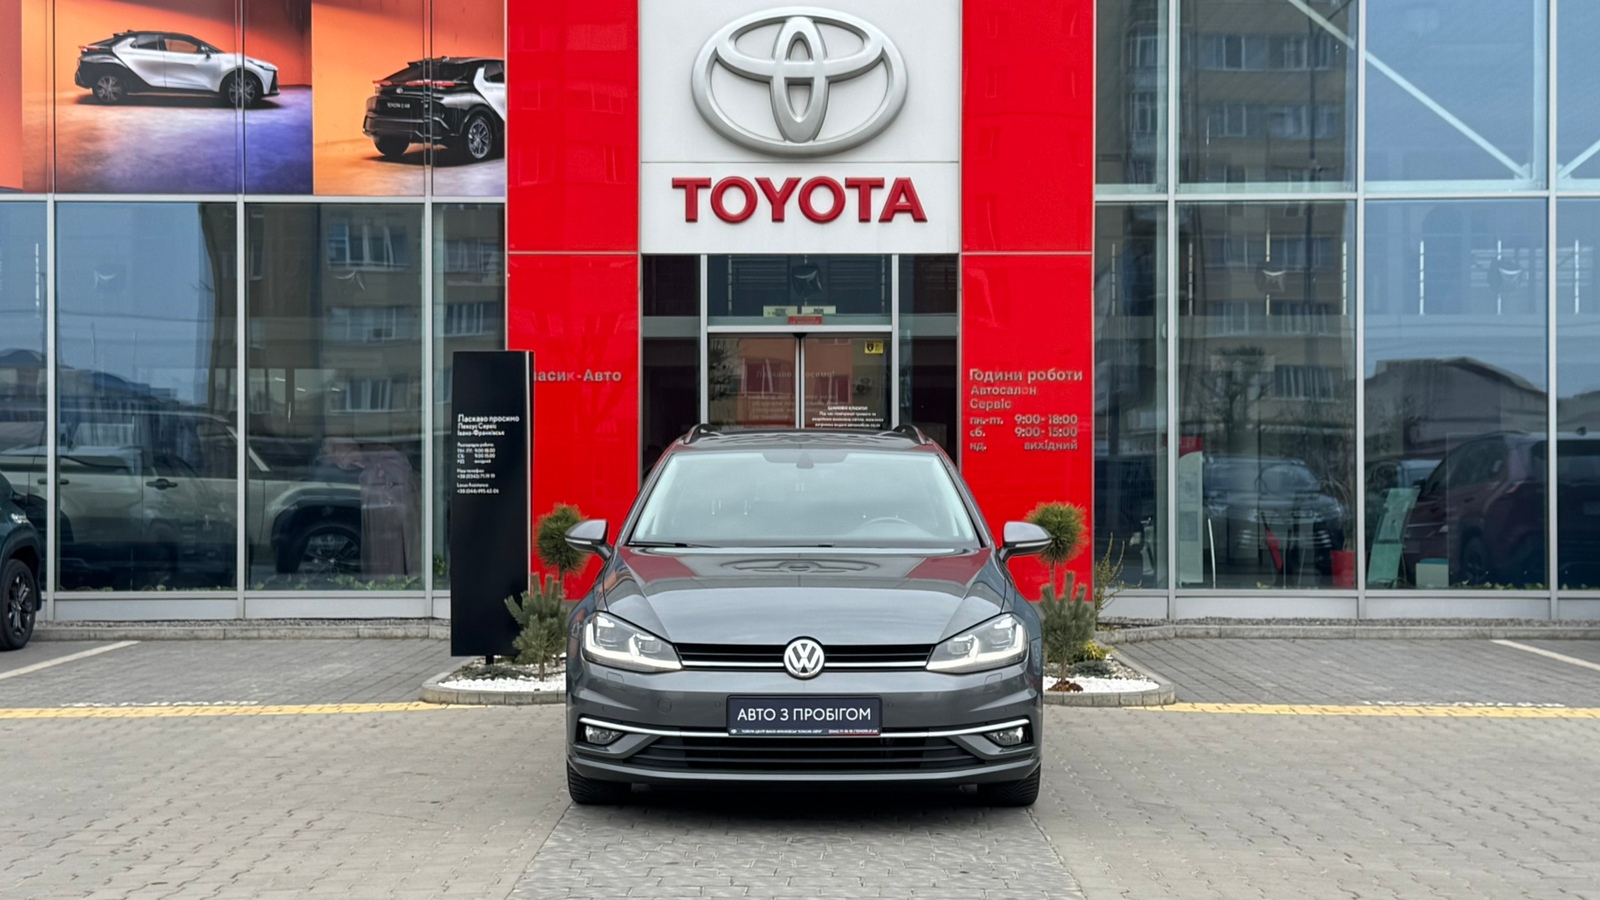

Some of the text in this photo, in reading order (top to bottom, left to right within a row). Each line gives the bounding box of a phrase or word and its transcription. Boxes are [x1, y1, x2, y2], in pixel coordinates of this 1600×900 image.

[671, 175, 928, 223] TOYOTA
[534, 369, 622, 382] асик-Авто
[969, 368, 1083, 383] Години роботи
[970, 386, 1037, 396] Автосалон
[969, 398, 1012, 411] Сервіс
[457, 414, 519, 423] Ласкаво просимо
[969, 427, 985, 437] сб.
[969, 440, 1078, 452] нд. вихідний
[737, 708, 776, 721] АВТО
[793, 708, 871, 721] ПРОБІГОМ
